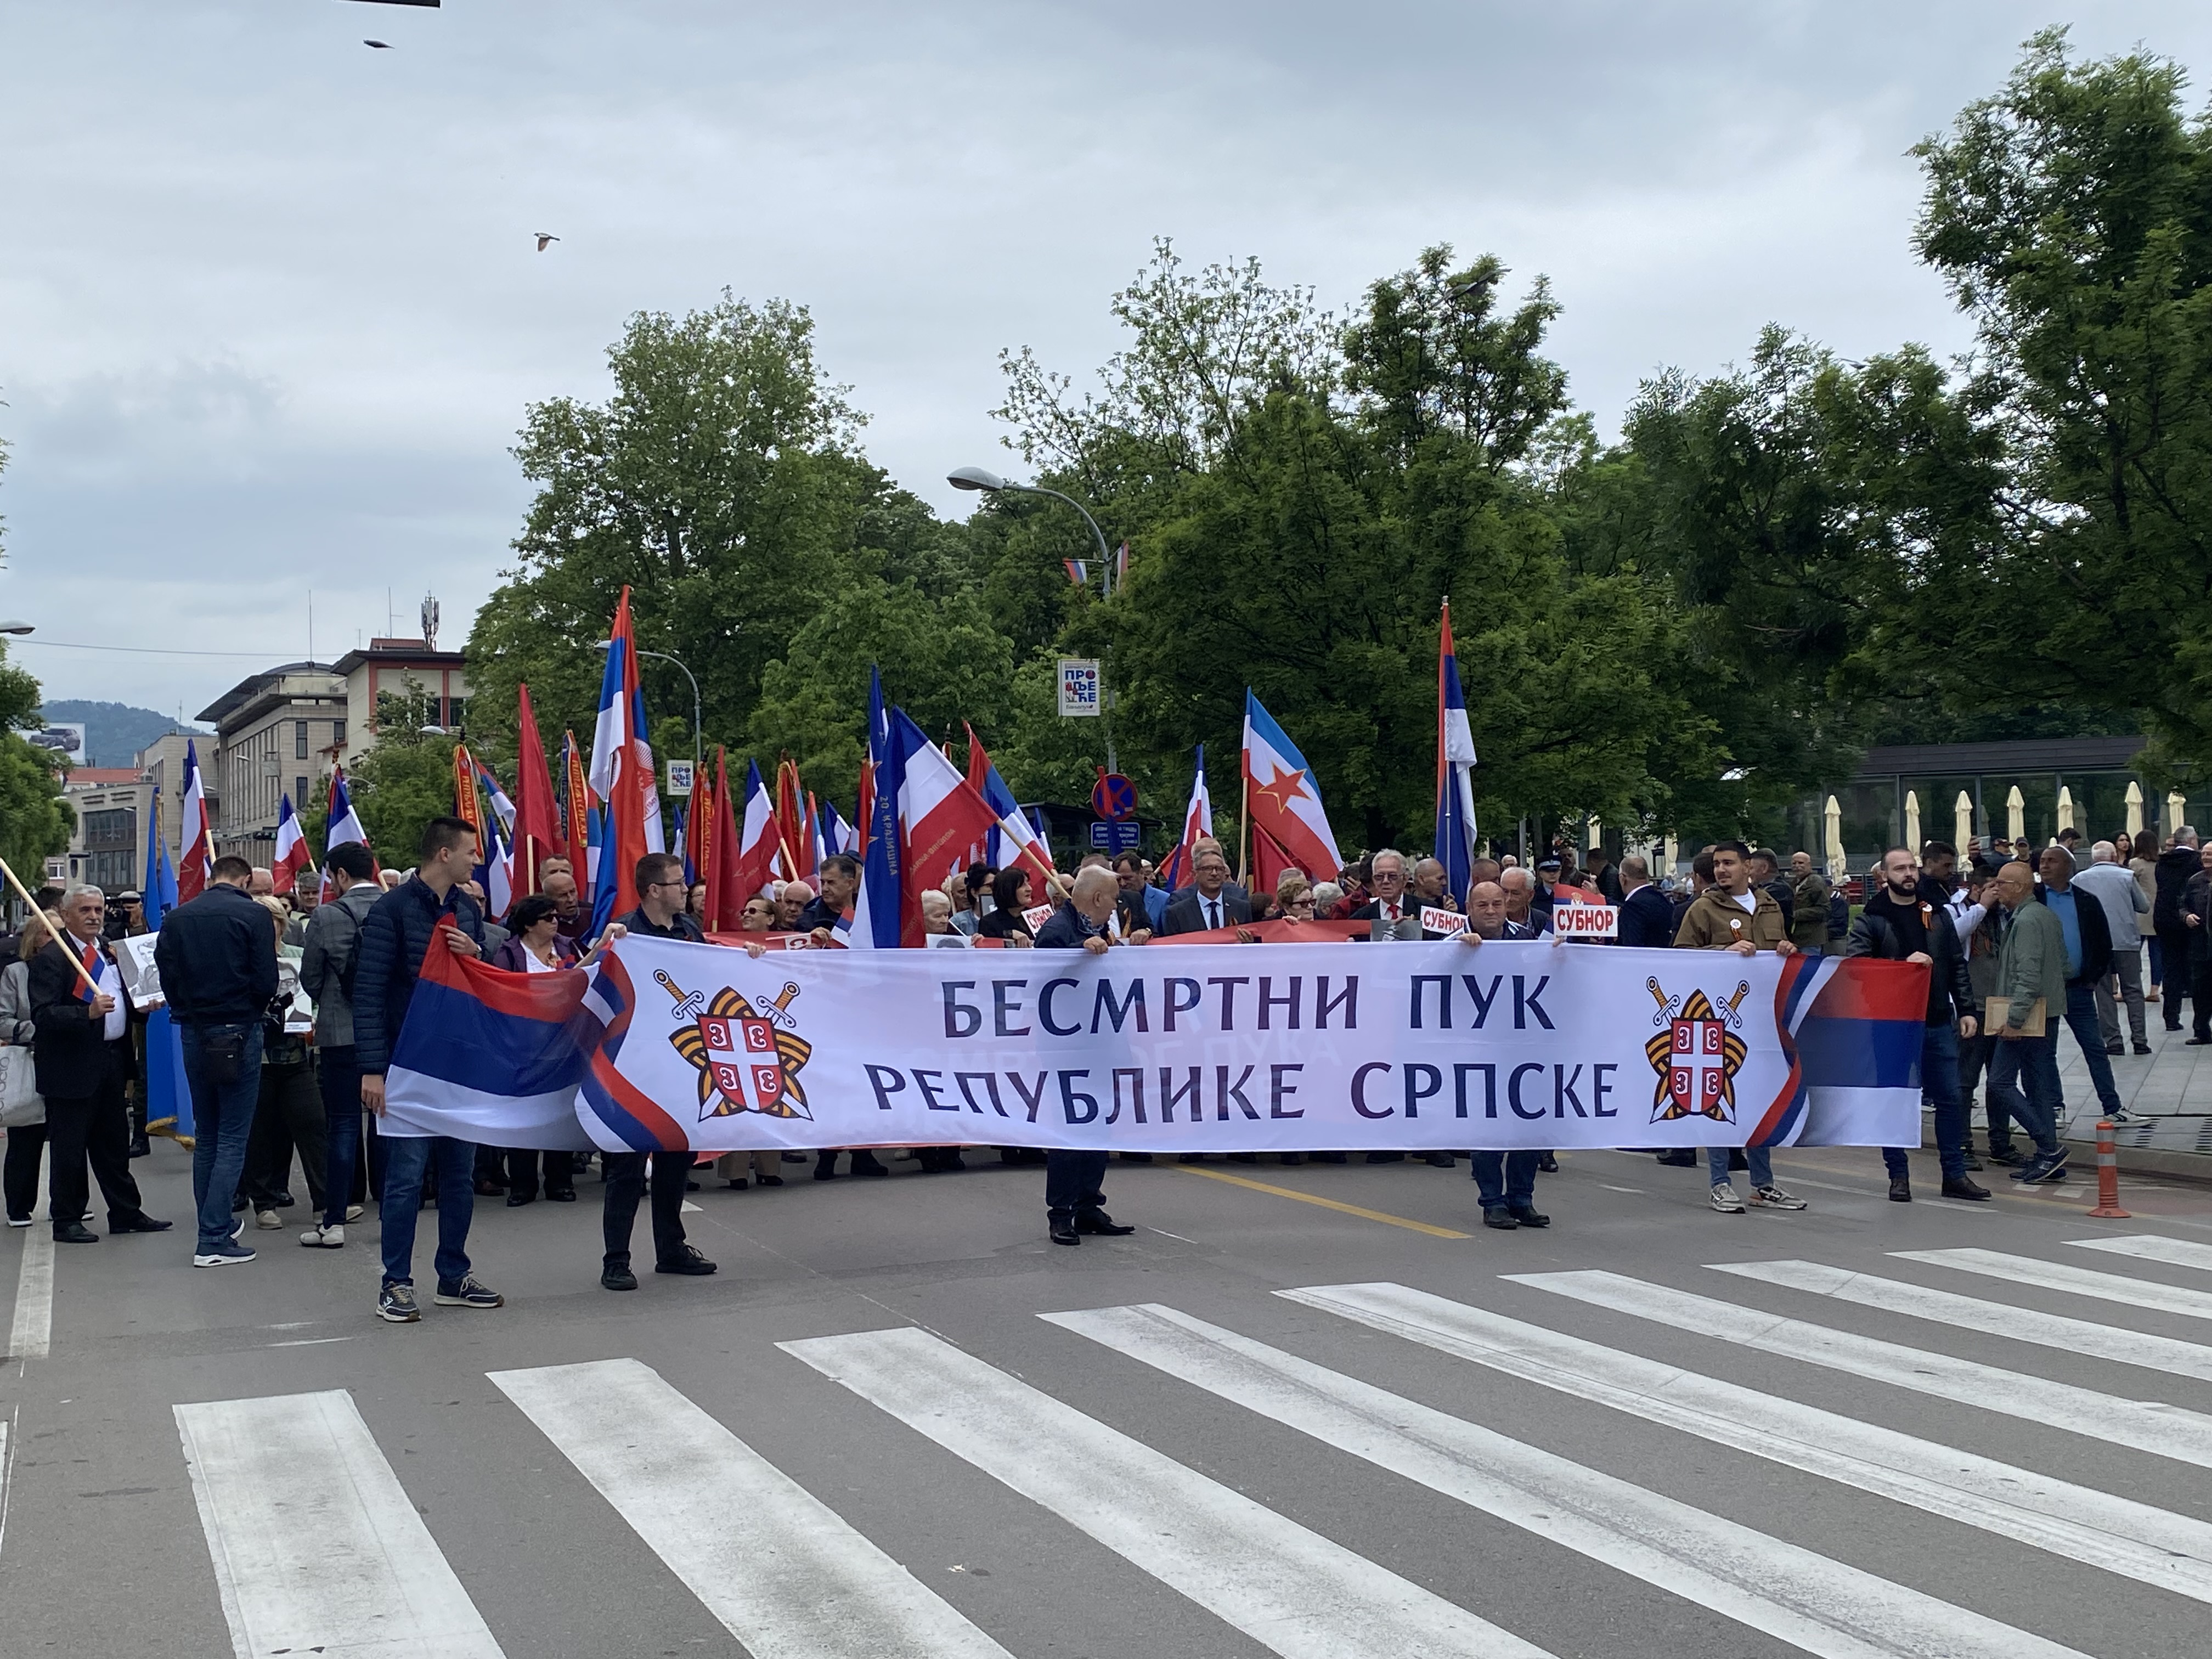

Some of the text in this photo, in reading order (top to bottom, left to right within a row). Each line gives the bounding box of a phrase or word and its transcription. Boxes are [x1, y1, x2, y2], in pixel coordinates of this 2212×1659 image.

[1558, 909, 1613, 931] СУБНОР
[941, 974, 1556, 1039] БЕСМРТНИ ПУК
[863, 1062, 1618, 1125] РЕПУБЛИКЕ СРПСКЕ
